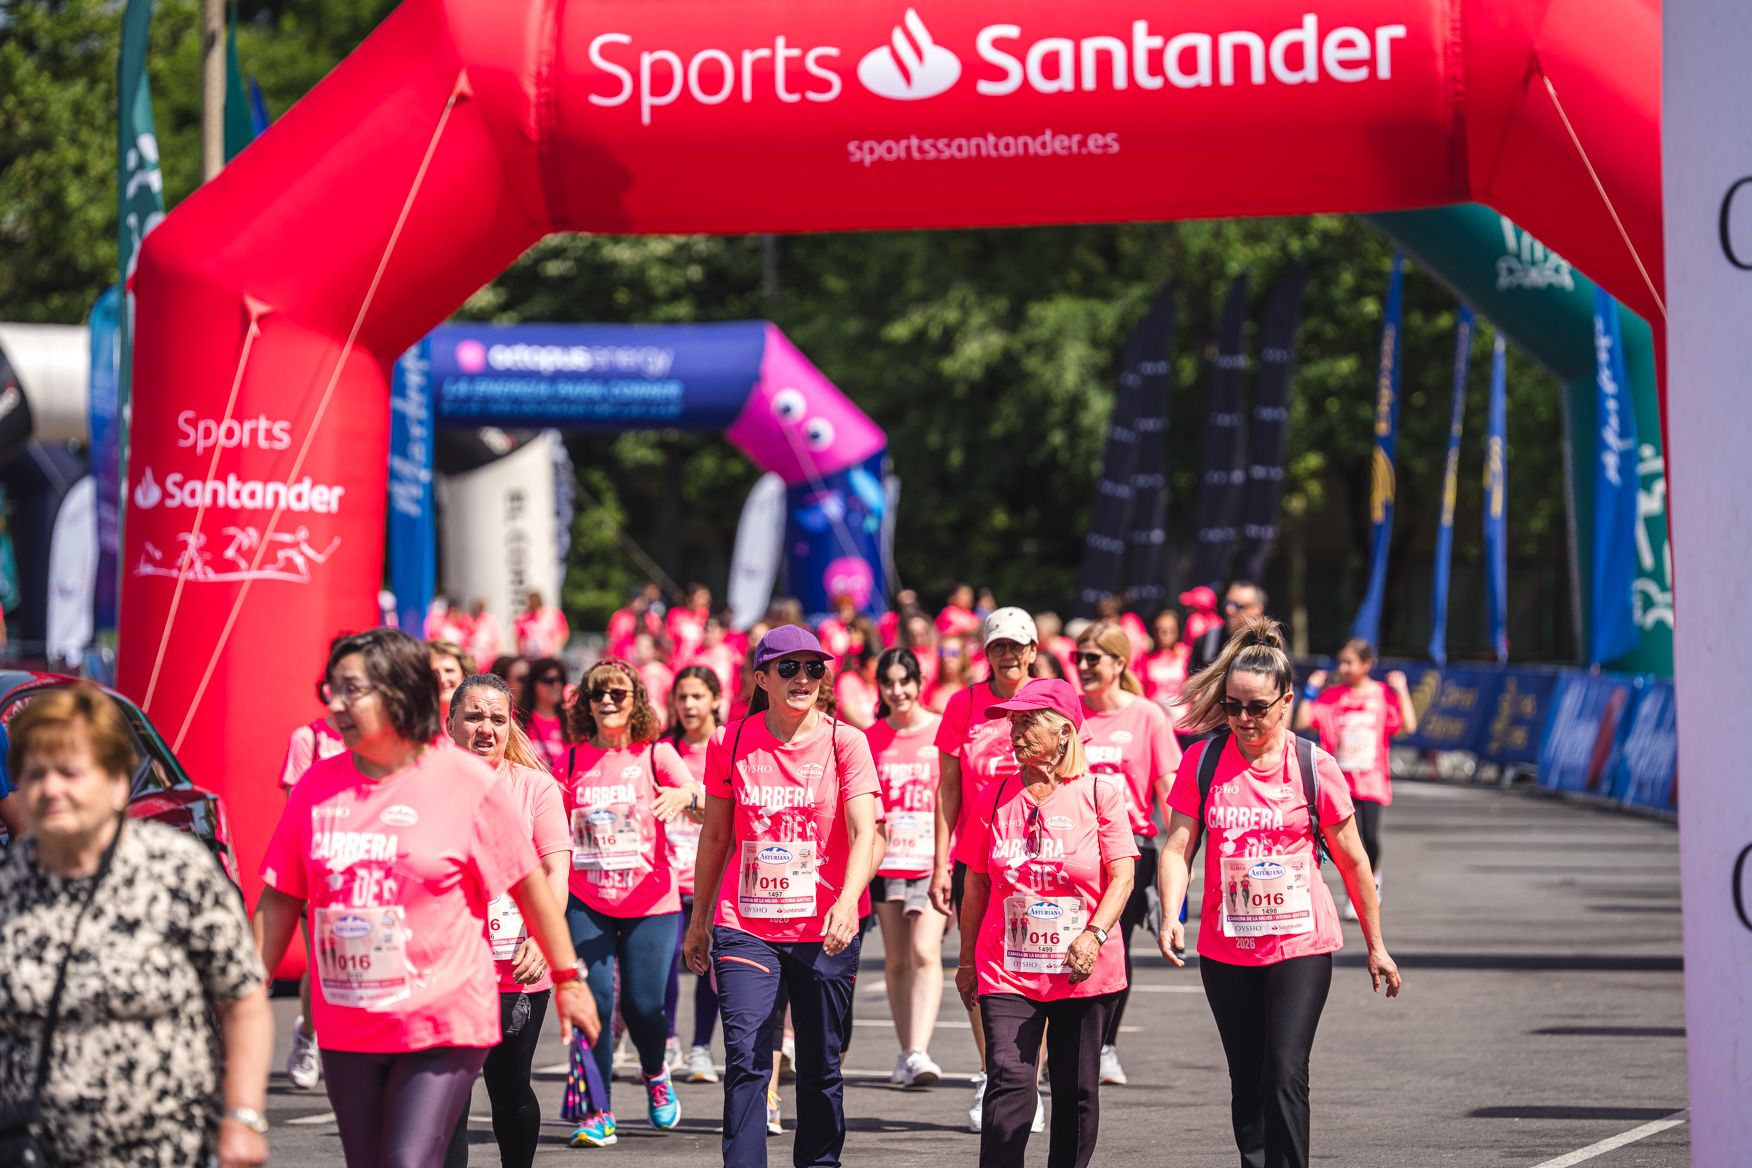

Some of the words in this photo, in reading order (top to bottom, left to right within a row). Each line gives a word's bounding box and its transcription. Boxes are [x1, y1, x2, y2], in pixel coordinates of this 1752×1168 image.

[587, 32, 842, 126] Sports
[976, 12, 1407, 97] Santander
[846, 128, 1120, 167] sportssantander.es
[176, 409, 292, 457] Sports
[164, 471, 346, 514] Santander
[740, 785, 815, 808] CARRERA
[1208, 806, 1284, 831] CARRERA
[993, 838, 1065, 861] CARRA
[760, 877, 790, 890] 016
[1252, 892, 1284, 906] 016
[1029, 931, 1060, 945] 016
[1235, 937, 1256, 949] 2026
[337, 953, 371, 971] 016
[1013, 960, 1038, 968] OYSHO
